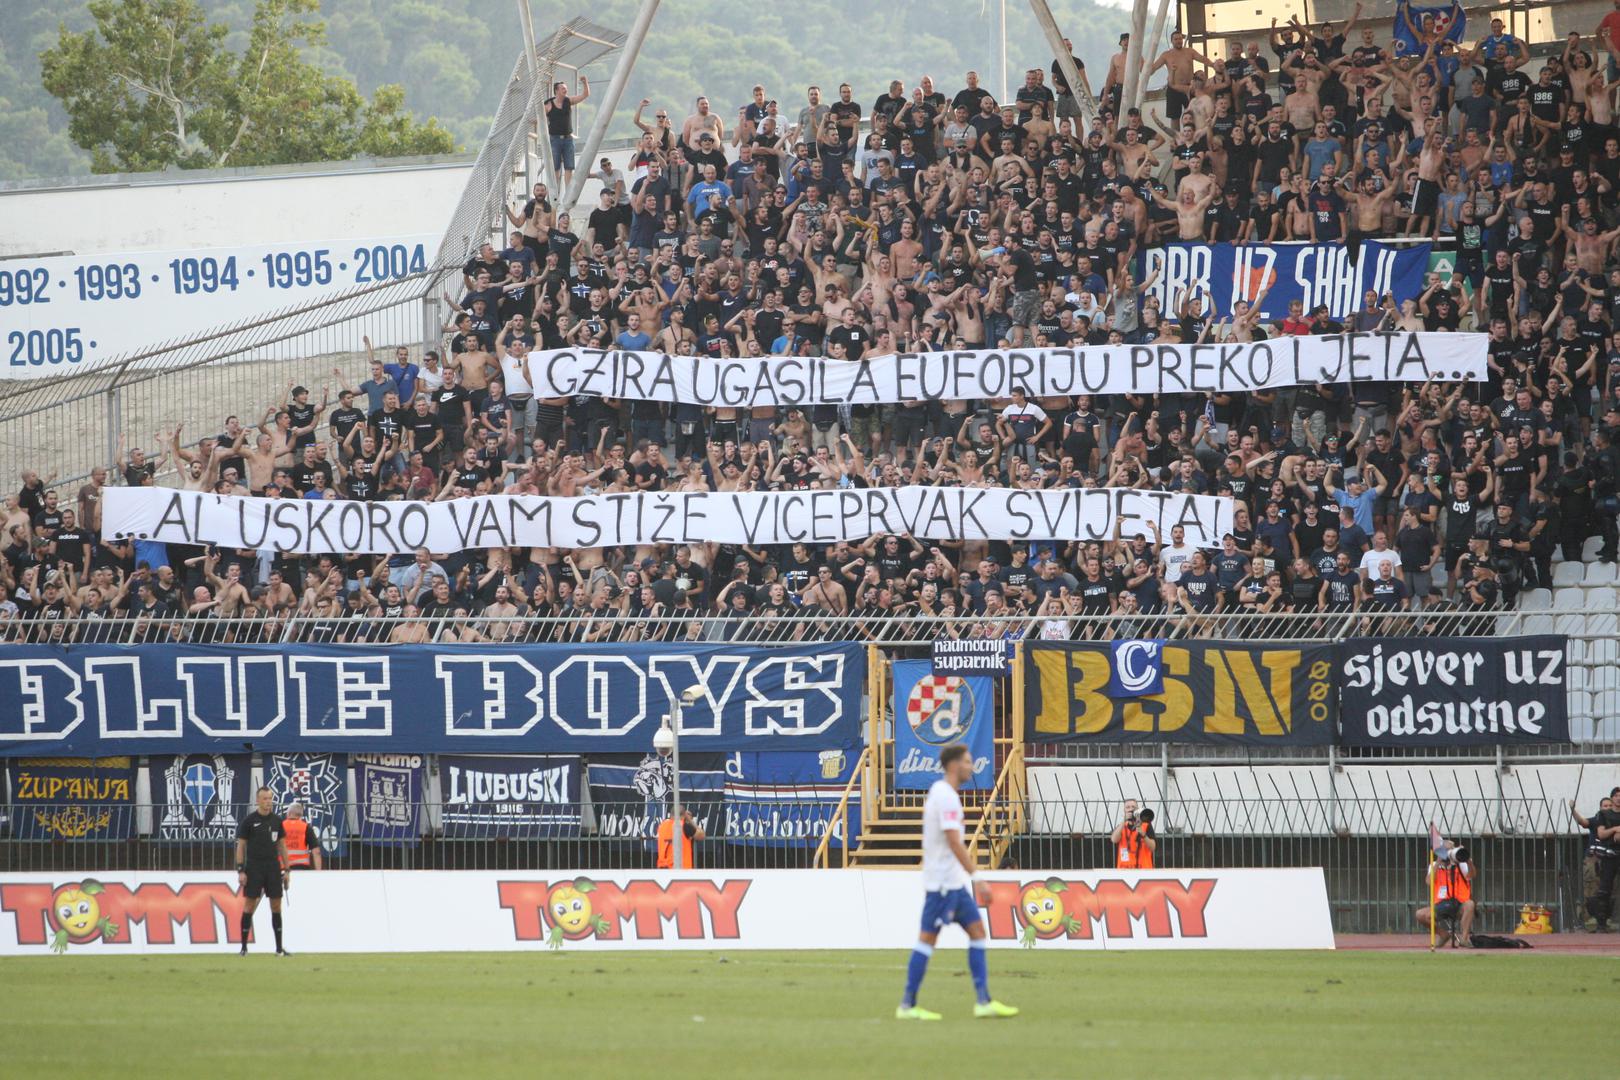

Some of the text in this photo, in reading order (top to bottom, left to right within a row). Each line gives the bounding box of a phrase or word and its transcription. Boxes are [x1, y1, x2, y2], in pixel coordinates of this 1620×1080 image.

[74, 263, 141, 300] 1993
[169, 256, 240, 294] 1994
[262, 249, 332, 288] 1995
[353, 243, 426, 283] 2004
[7, 328, 84, 366] 2005
[692, 358, 880, 406] UGASILA
[896, 350, 1110, 401] EUFORIJU
[1131, 344, 1273, 394] PREKO
[239, 501, 430, 552] USKORO
[447, 498, 551, 548] VAM
[572, 493, 709, 547] STIŽE
[733, 488, 989, 545] VICEPRVAK
[1005, 488, 1221, 548] SVIJETA!
[934, 653, 1006, 671] suparnik
[1115, 640, 1158, 691] C
[1344, 643, 1563, 697] sjever uz
[0, 654, 846, 740] BLUE BOYS
[1031, 646, 1302, 736] BSN
[1366, 694, 1546, 738] odsutne
[448, 764, 570, 810] LJUBUŠKI
[161, 827, 237, 841] VUKOVAR
[1, 881, 256, 945] TOMMY
[497, 879, 753, 941] TOMMY
[971, 878, 1218, 940] TOMMY
